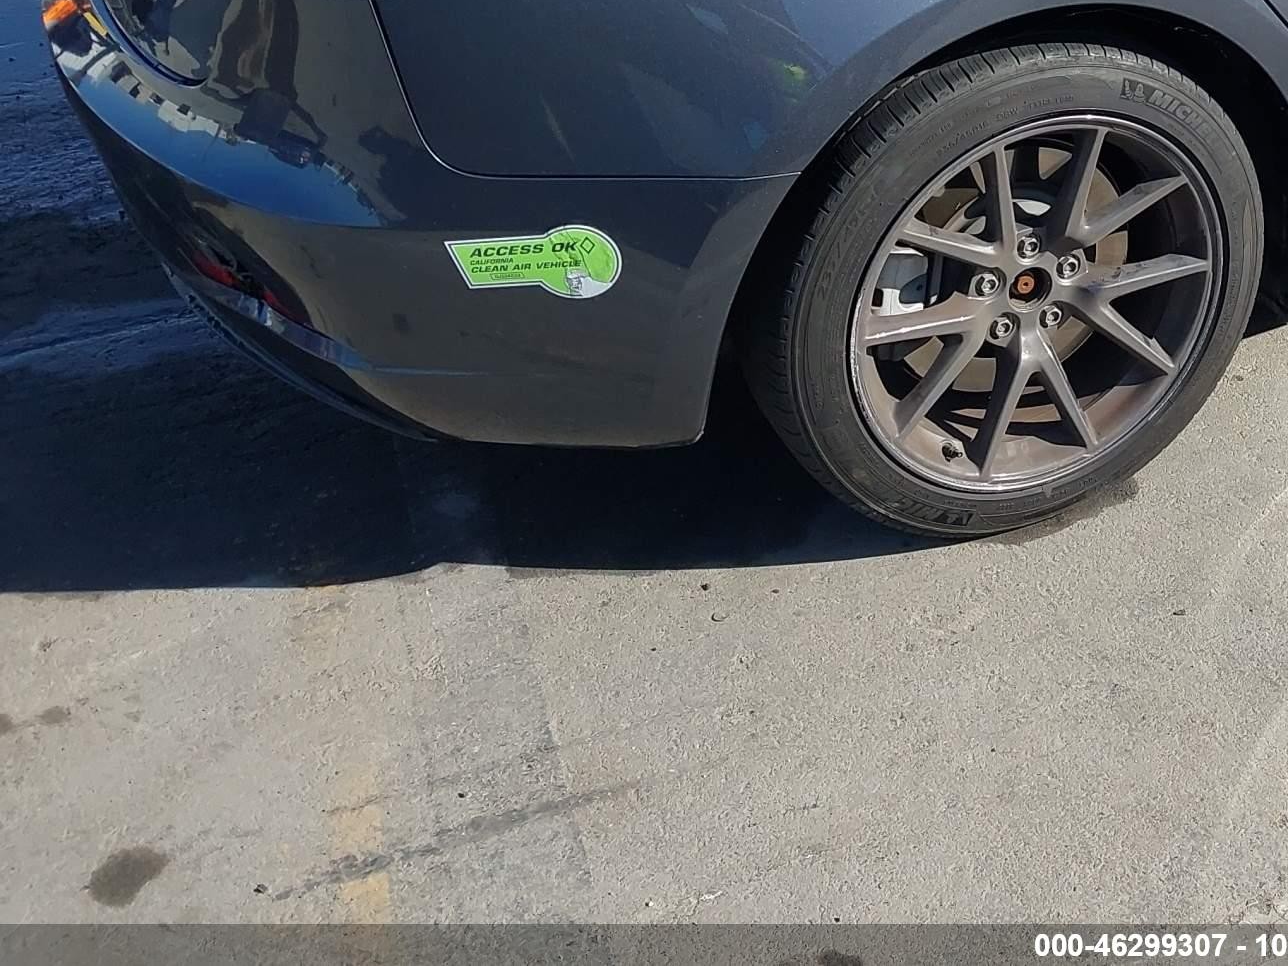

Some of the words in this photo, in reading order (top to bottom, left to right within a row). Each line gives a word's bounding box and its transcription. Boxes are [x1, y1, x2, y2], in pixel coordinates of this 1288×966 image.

[470, 243, 545, 258] ACCESS
[552, 241, 578, 253] OK
[470, 257, 514, 266] CALIFORNIA
[471, 265, 509, 274] CLEAN
[512, 262, 532, 271] AIR
[536, 259, 582, 270] VEHICLE
